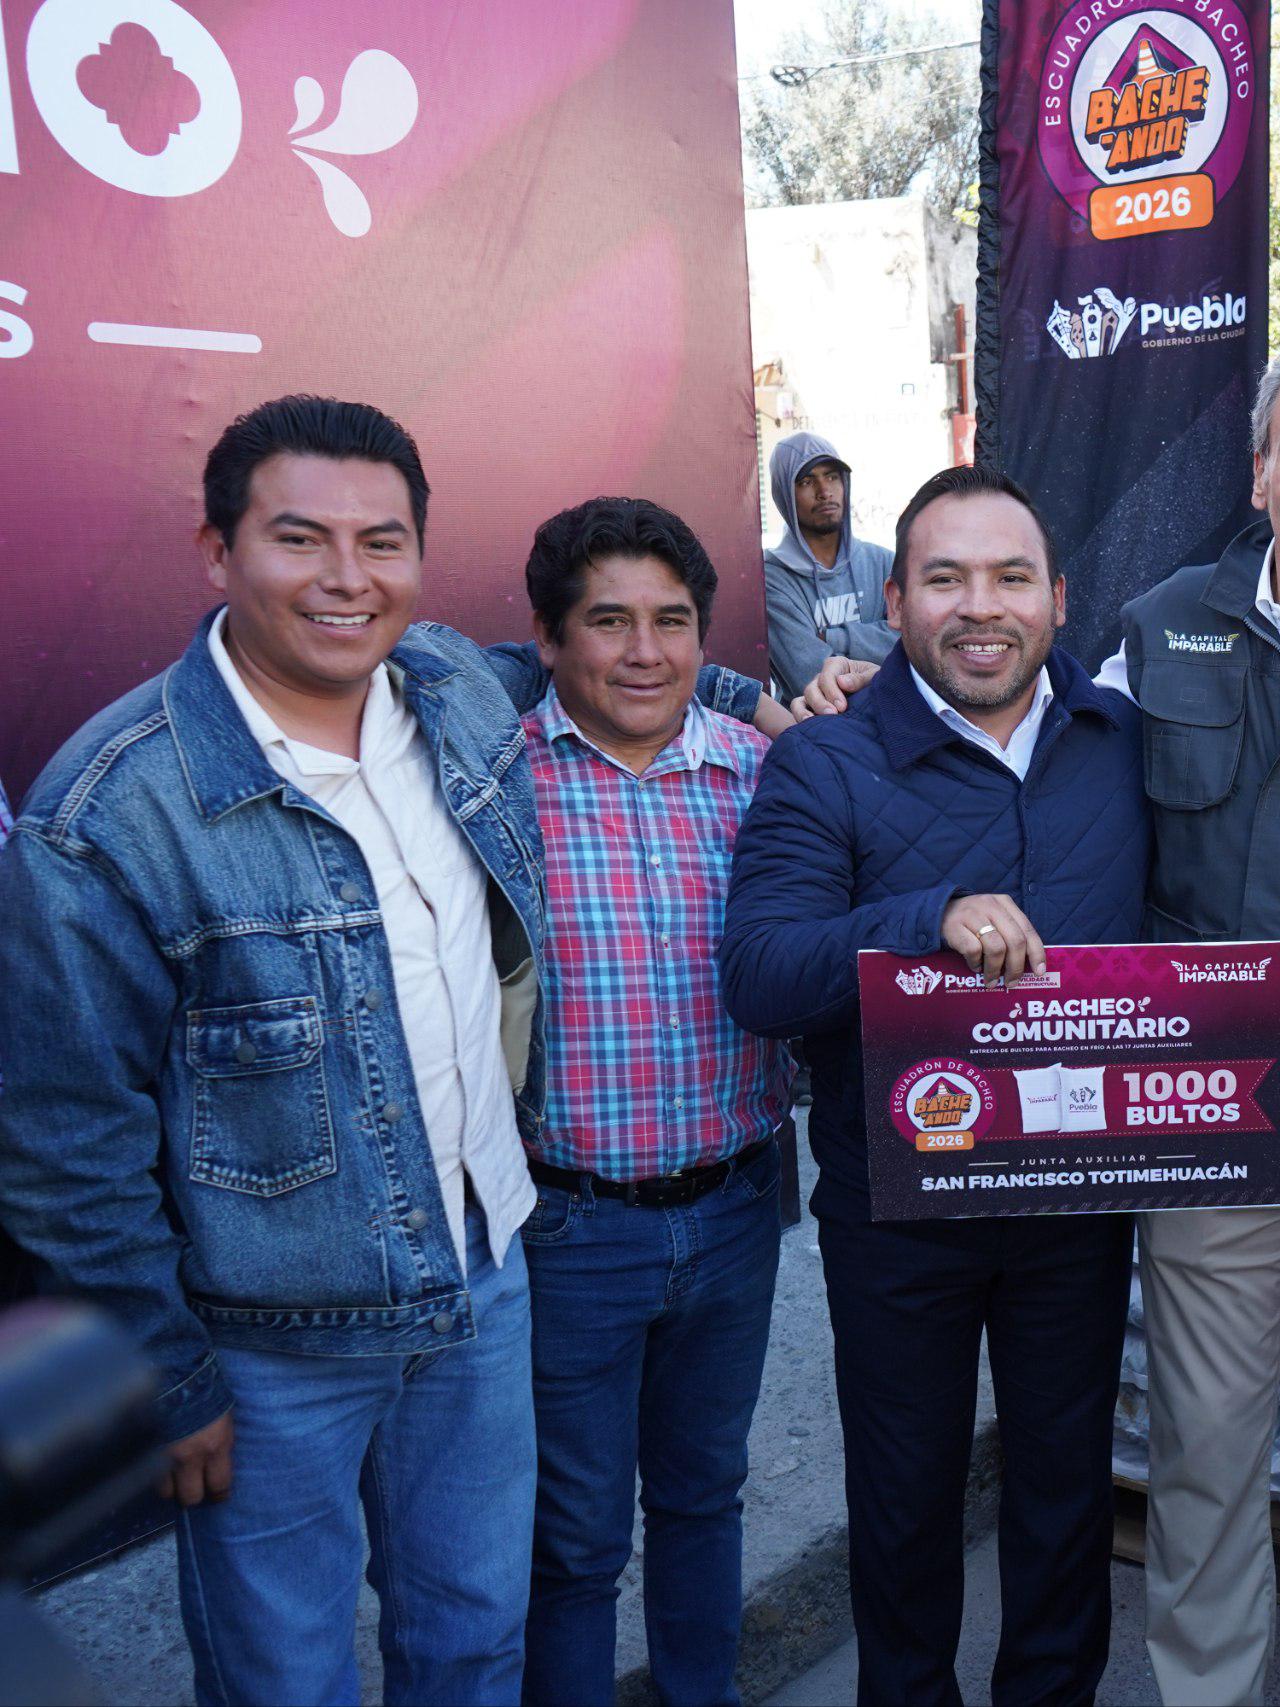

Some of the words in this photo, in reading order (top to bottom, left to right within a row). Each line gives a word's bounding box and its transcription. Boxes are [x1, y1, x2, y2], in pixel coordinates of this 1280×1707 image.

[1045, 0, 1134, 126] ESCUADR
[1195, 0, 1250, 99] BACHEO
[0, 0, 242, 197] O
[1085, 66, 1211, 145] BACHE
[1115, 187, 1191, 226] 2026
[1141, 293, 1246, 336] Puebla
[1142, 336, 1192, 348] GOBIERNO
[1195, 335, 1206, 344] DE
[1208, 333, 1219, 341] LA
[1168, 640, 1233, 652] IMPARABLE
[1179, 969, 1266, 983] IMPARABLE
[1184, 963, 1199, 971] LA
[1205, 962, 1259, 970] CAPITAL
[1028, 997, 1135, 1018] BACHEO
[972, 1016, 1191, 1043] COMUNITARIO
[894, 1061, 942, 1113] ESCUADRÓN
[948, 1061, 964, 1071] DE
[966, 1068, 993, 1110] BACHEO
[1123, 1069, 1237, 1103] 1000
[914, 1094, 973, 1118] BACHE
[1126, 1102, 1241, 1126] BULTOS
[927, 1134, 964, 1147] 2026
[1020, 1157, 1066, 1166] JUNTA
[1075, 1154, 1146, 1164] AUXILIAR
[921, 1176, 964, 1191] SAN
[968, 1171, 1085, 1189] FRANCISCO
[1088, 1162, 1248, 1185] TOTIMEHUACÁN
